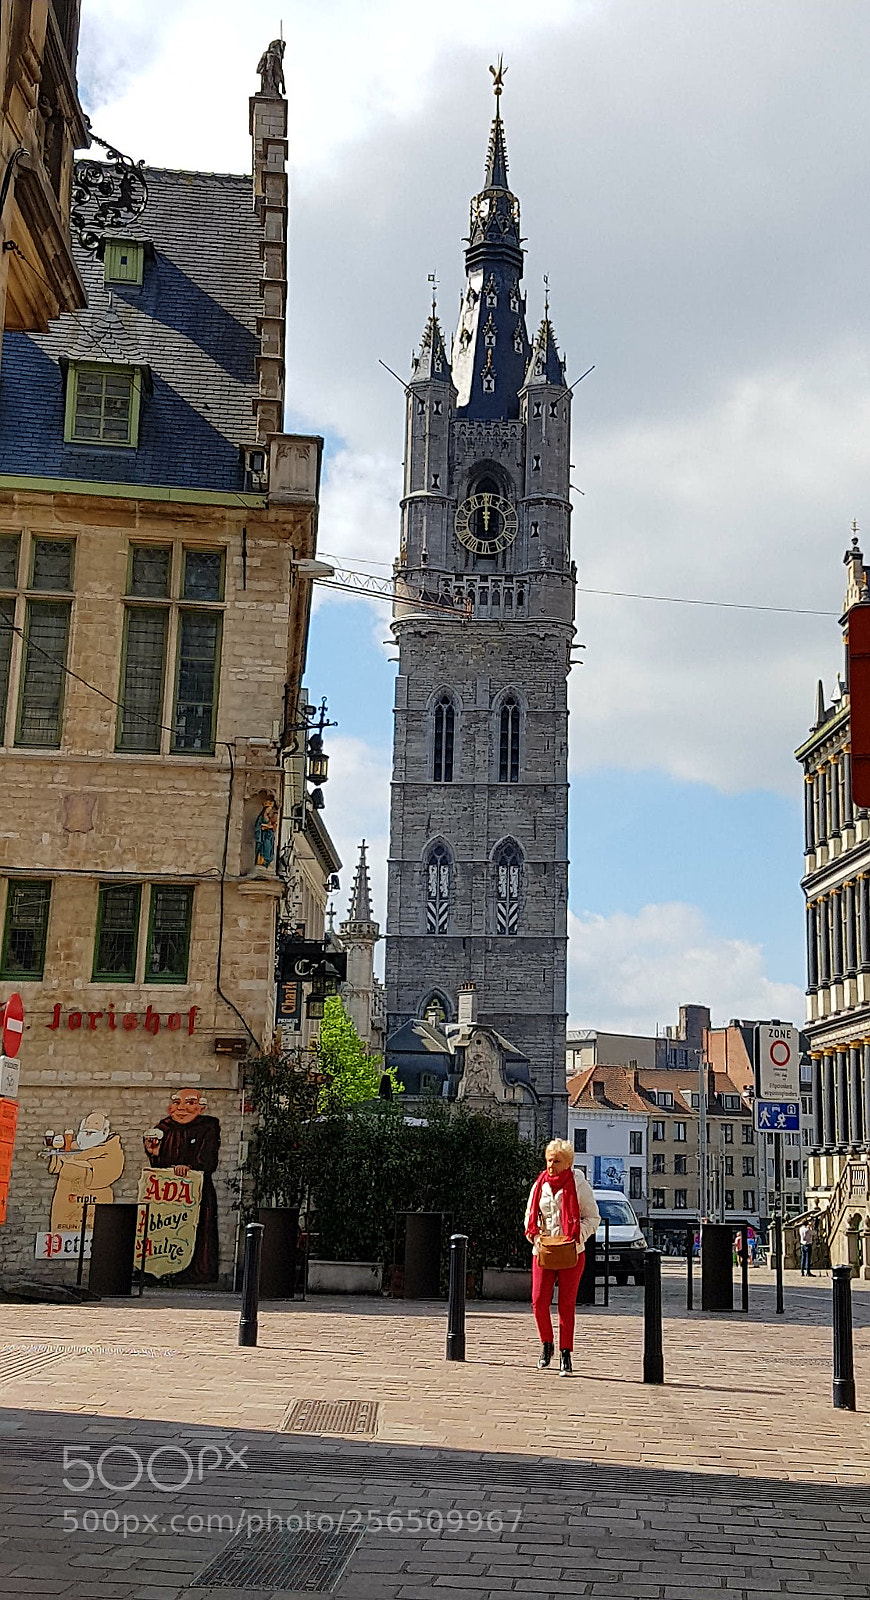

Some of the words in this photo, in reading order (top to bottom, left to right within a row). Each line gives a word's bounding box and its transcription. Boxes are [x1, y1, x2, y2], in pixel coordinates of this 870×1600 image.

[45, 1003, 201, 1036] Jorishof
[768, 1028, 792, 1039] ZONE
[143, 1174, 194, 1205] ADA
